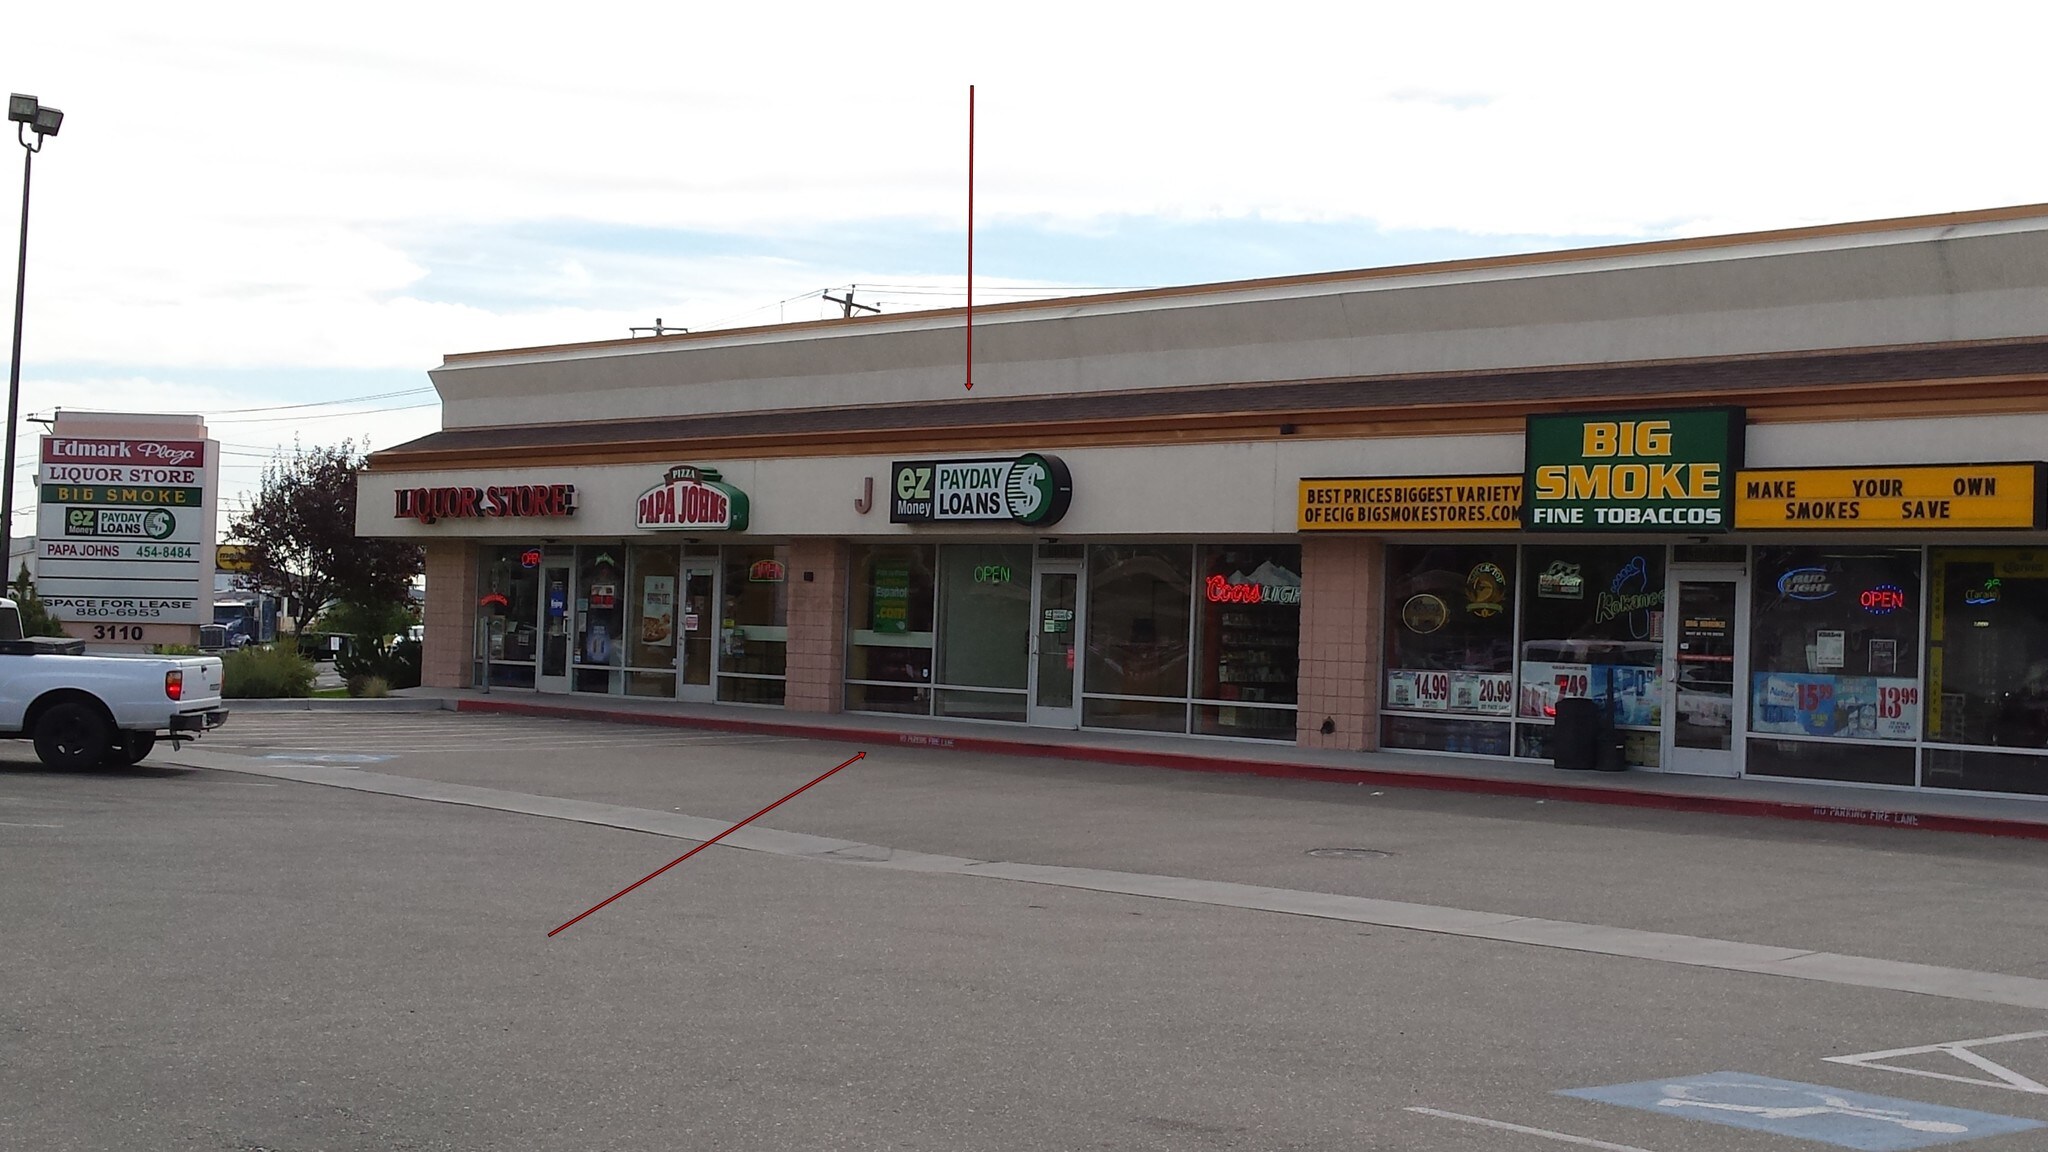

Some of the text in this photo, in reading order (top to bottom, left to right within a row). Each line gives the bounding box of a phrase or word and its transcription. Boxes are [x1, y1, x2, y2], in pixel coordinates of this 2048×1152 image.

[1582, 421, 1672, 457] BIG
[52, 440, 195, 464] Edmark Plaza
[50, 467, 195, 483] LIQUOR STORE
[672, 469, 695, 479] PIZZA
[940, 467, 1003, 490] PAYDAY
[1536, 463, 1720, 499] SMOKE
[897, 468, 931, 500] ez
[1747, 477, 1996, 499] MAKE YOUR OWN
[58, 488, 186, 503] BIG SMOKE
[854, 477, 873, 514] J
[1307, 485, 1521, 504] BEST PRICES BIGGEST VARIETY
[394, 484, 573, 524] LIQUOR STORE
[639, 487, 675, 523] PAPA
[897, 500, 931, 517] Money
[939, 493, 1001, 515] LOANS
[1785, 501, 1950, 520] SMOKES SAVE
[101, 512, 142, 523] PAYDAY
[1305, 505, 1521, 522] OF ECIG BIGSMOKESTORES.COM
[1533, 508, 1721, 524] FINE TOBACCOS
[69, 525, 94, 535] Money
[101, 523, 141, 534] LOANS
[47, 544, 192, 558] PAPA JOHNS 454-8484
[974, 566, 1010, 583] OPEN
[1206, 575, 1301, 605] Coors LIGH
[1785, 583, 1831, 593] LIGHT
[43, 599, 192, 609] SPACE FOR LEASE
[1860, 591, 1904, 608] OPEN
[76, 608, 160, 617] 880-6953
[93, 626, 143, 640] 3110
[1415, 674, 1447, 700] 14.99
[1479, 679, 1512, 702] 20.99
[1813, 805, 1918, 826] NO PARKING FIRE LANE
